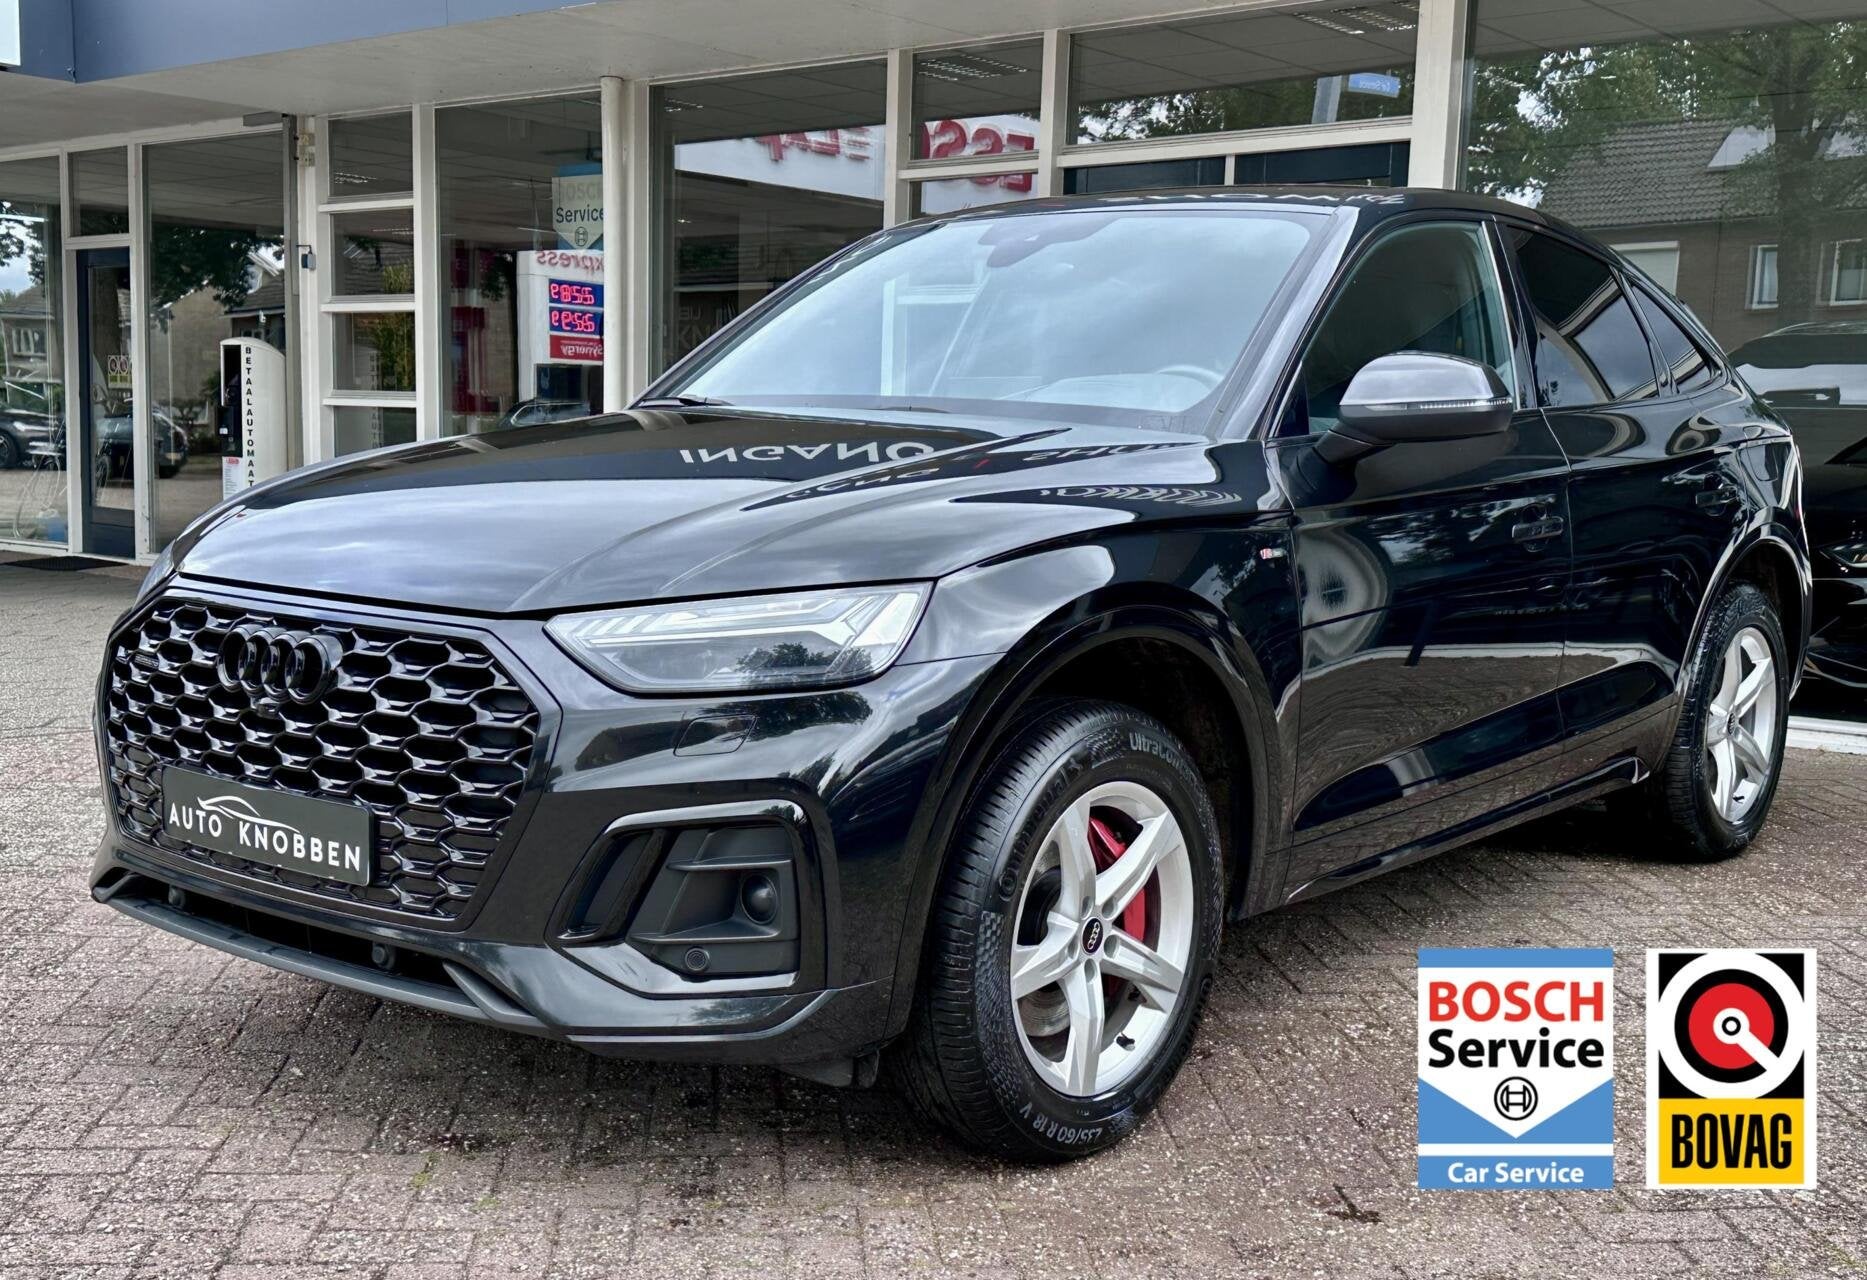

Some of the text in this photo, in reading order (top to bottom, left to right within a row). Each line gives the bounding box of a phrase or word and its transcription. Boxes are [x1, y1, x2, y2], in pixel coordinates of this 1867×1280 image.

[245, 346, 255, 487] BETAALAUTOMAAT
[169, 802, 361, 872] AUTO KNOBBEN
